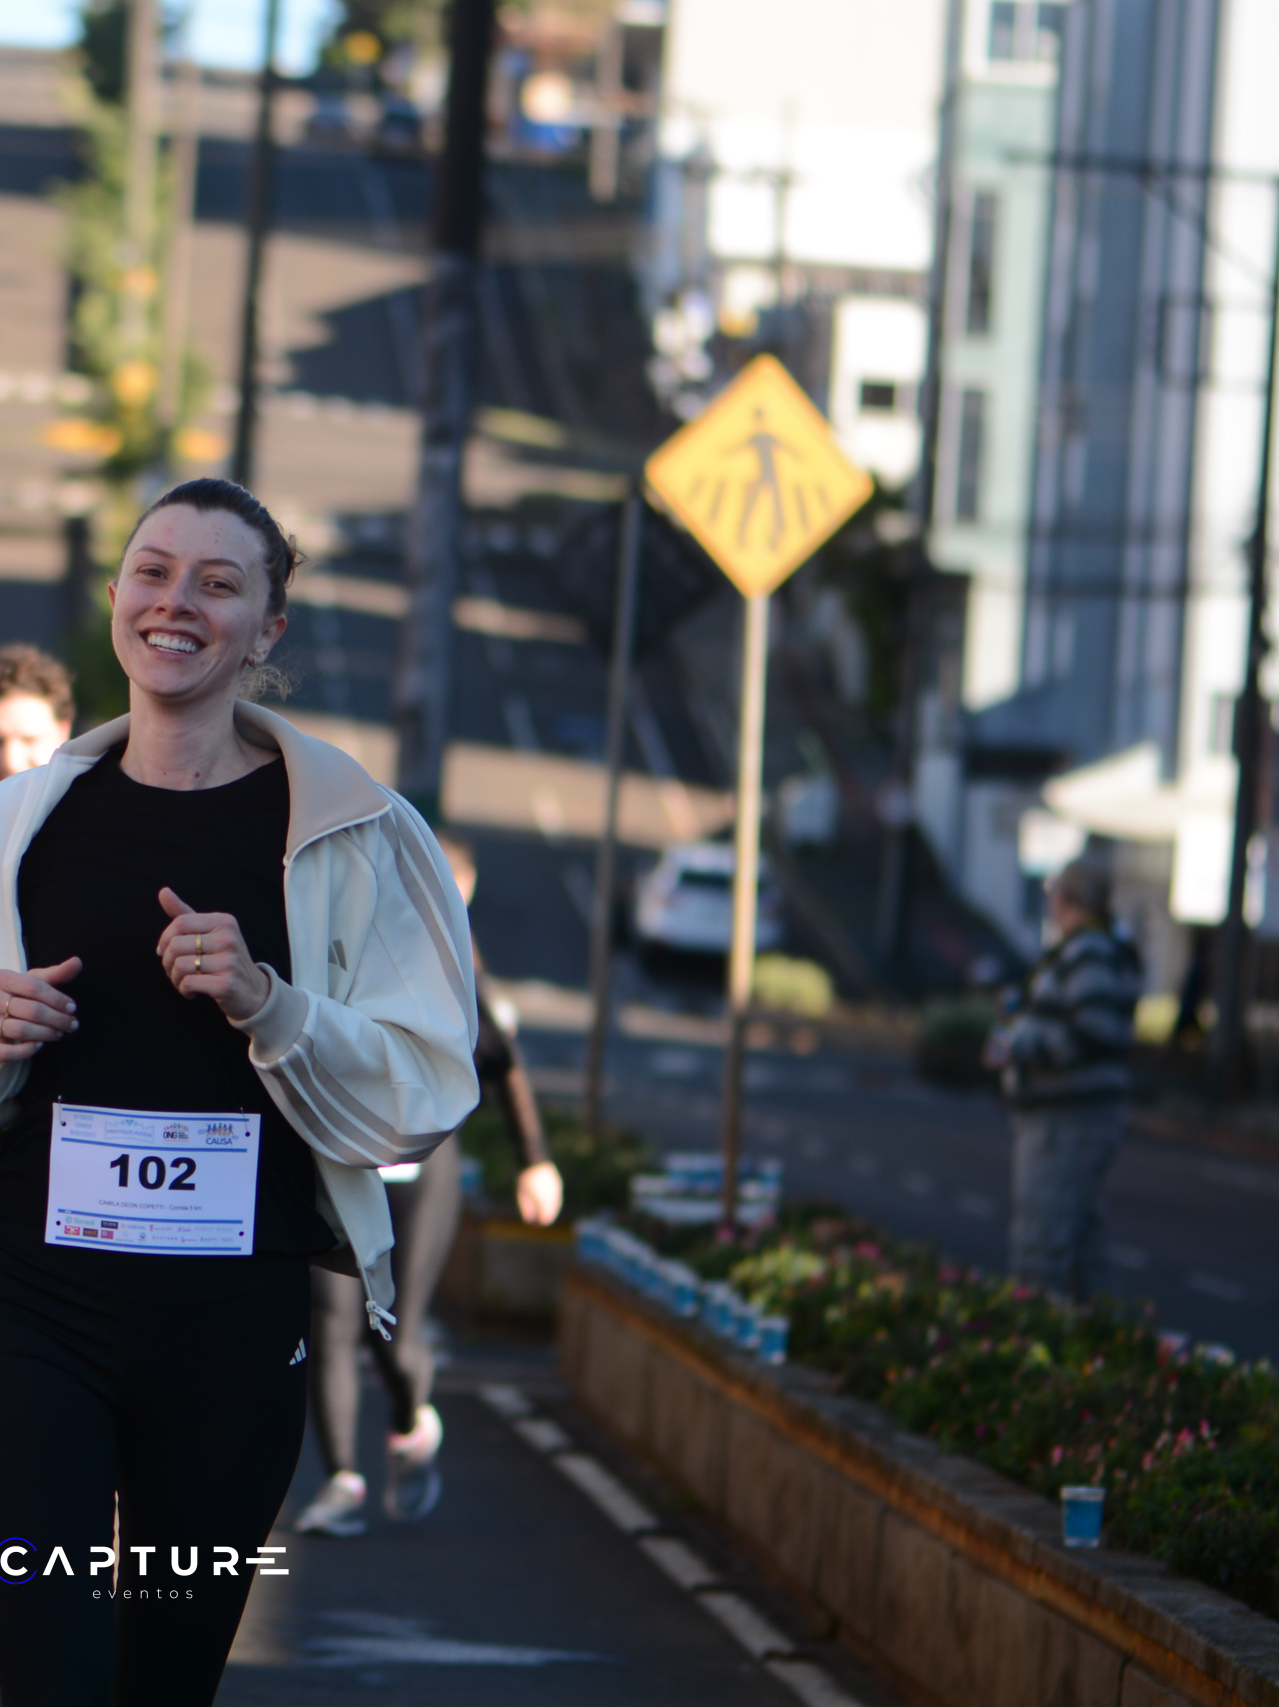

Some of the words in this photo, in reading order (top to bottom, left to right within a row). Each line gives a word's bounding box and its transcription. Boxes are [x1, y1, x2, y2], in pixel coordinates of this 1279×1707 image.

[205, 1137, 233, 1145] CAUSA
[109, 1153, 197, 1191] 102
[98, 1199, 120, 1207] CAMILA
